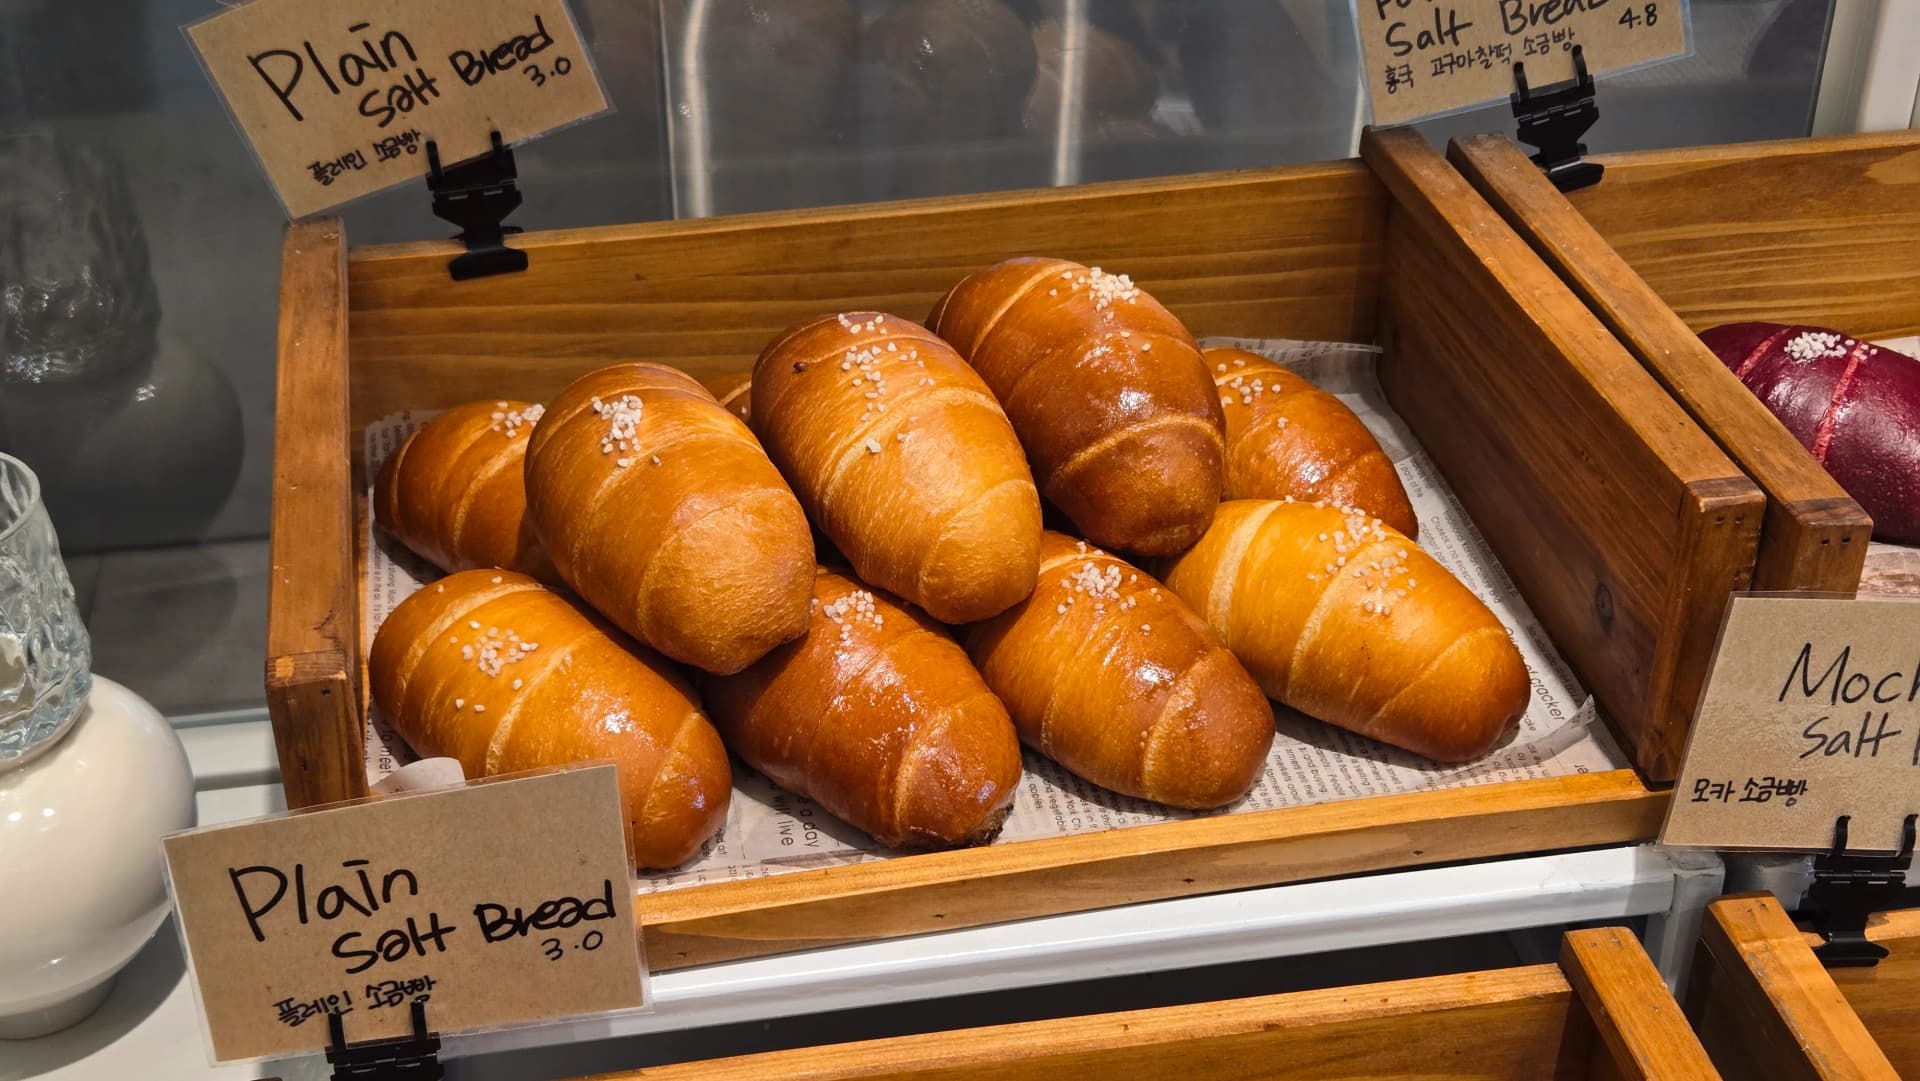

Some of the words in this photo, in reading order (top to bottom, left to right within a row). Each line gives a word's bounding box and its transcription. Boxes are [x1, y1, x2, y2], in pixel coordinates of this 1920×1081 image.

[1385, 7, 1473, 57] Salt
[1619, 4, 1658, 29] 4.8
[1524, 27, 1575, 57] 소금빵
[359, 68, 440, 128] Salt
[449, 15, 554, 86] Bread
[523, 57, 572, 87] 3.0
[306, 149, 368, 186] 플레인
[372, 128, 421, 162] 소금빵
[1530, 676, 1566, 721] cracker
[1799, 711, 1902, 759] Salt
[1691, 778, 1736, 803] 모카
[1739, 776, 1808, 807] 소금빵
[776, 819, 795, 847] live
[802, 820, 820, 848] day
[331, 912, 457, 974] Salt
[473, 879, 616, 943] Bread
[542, 930, 604, 961] 3.0
[272, 990, 354, 1027] 플레인
[366, 975, 437, 1010] 소금빵
